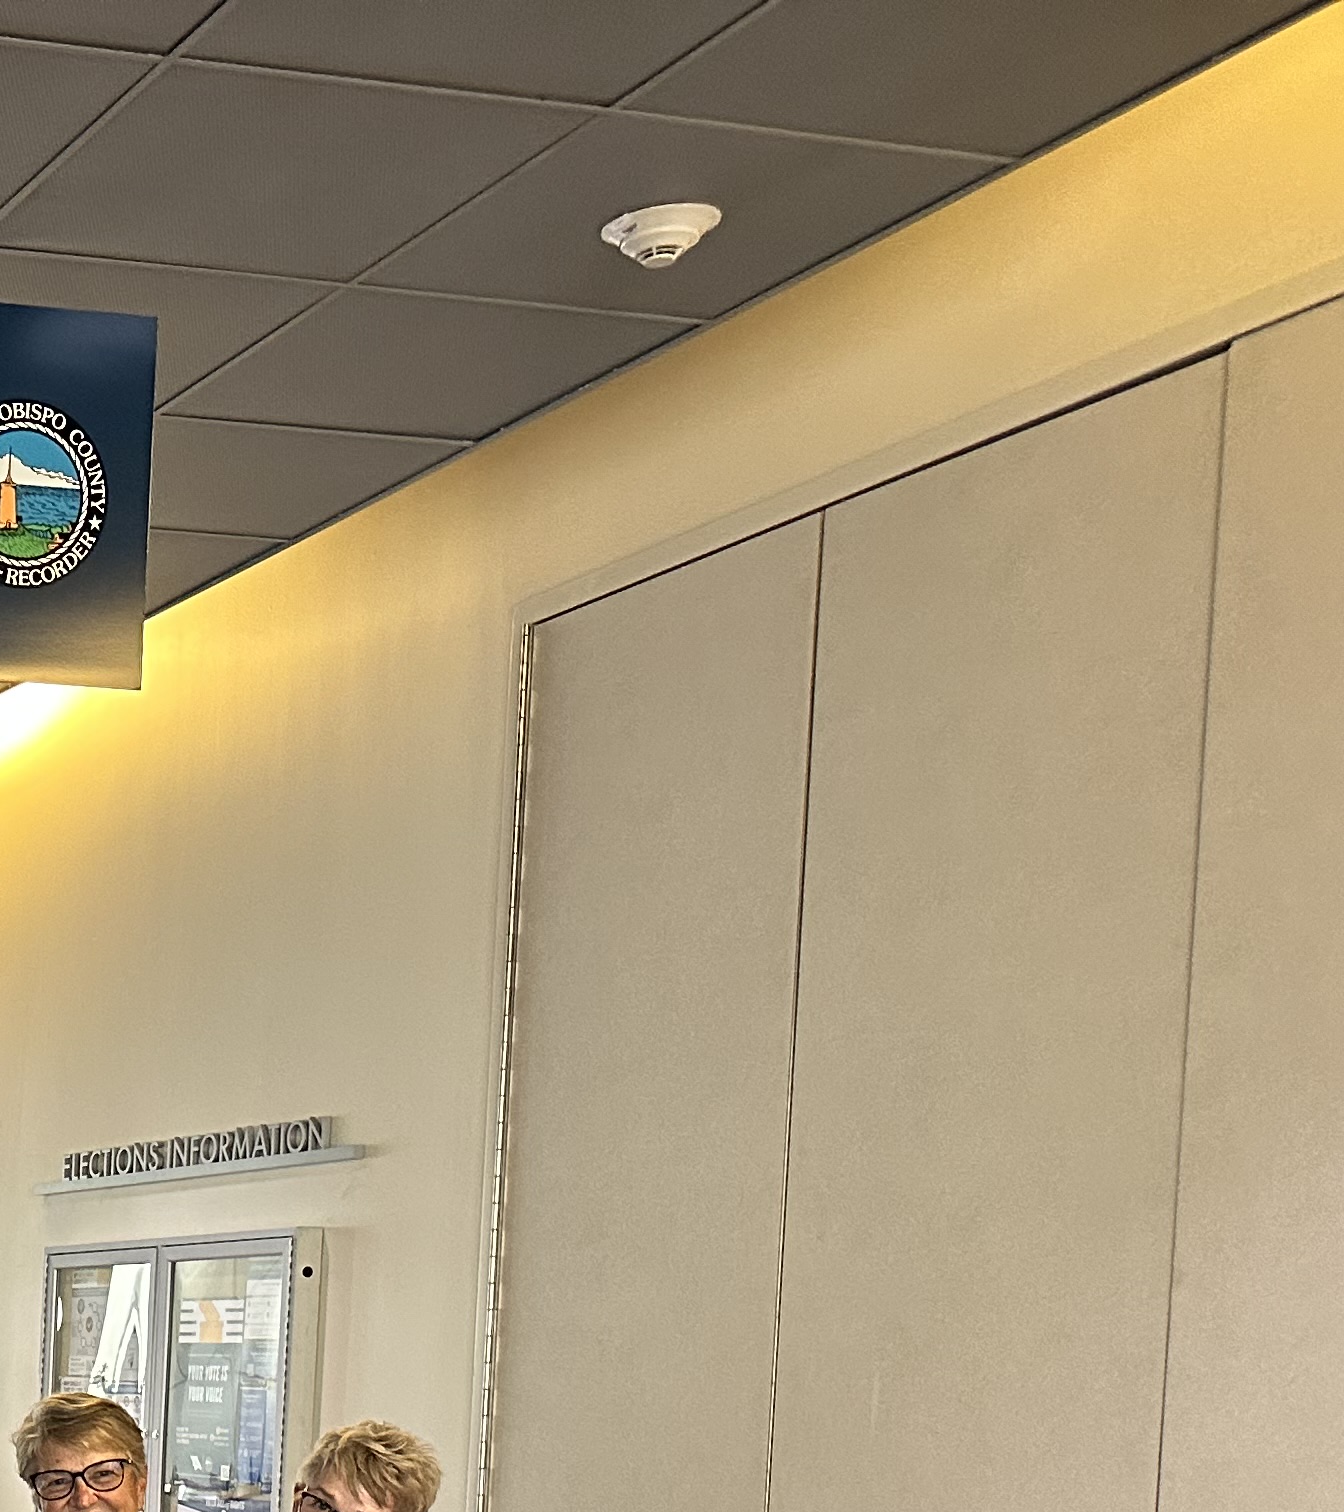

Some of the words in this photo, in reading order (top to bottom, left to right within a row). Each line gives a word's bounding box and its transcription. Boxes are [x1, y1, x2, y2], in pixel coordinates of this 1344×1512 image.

[69, 429, 106, 514] COUNTY
[5, 531, 97, 586] RECORDER
[63, 1141, 159, 1181] ELECTIONS
[165, 1116, 330, 1169] INFORMATION
